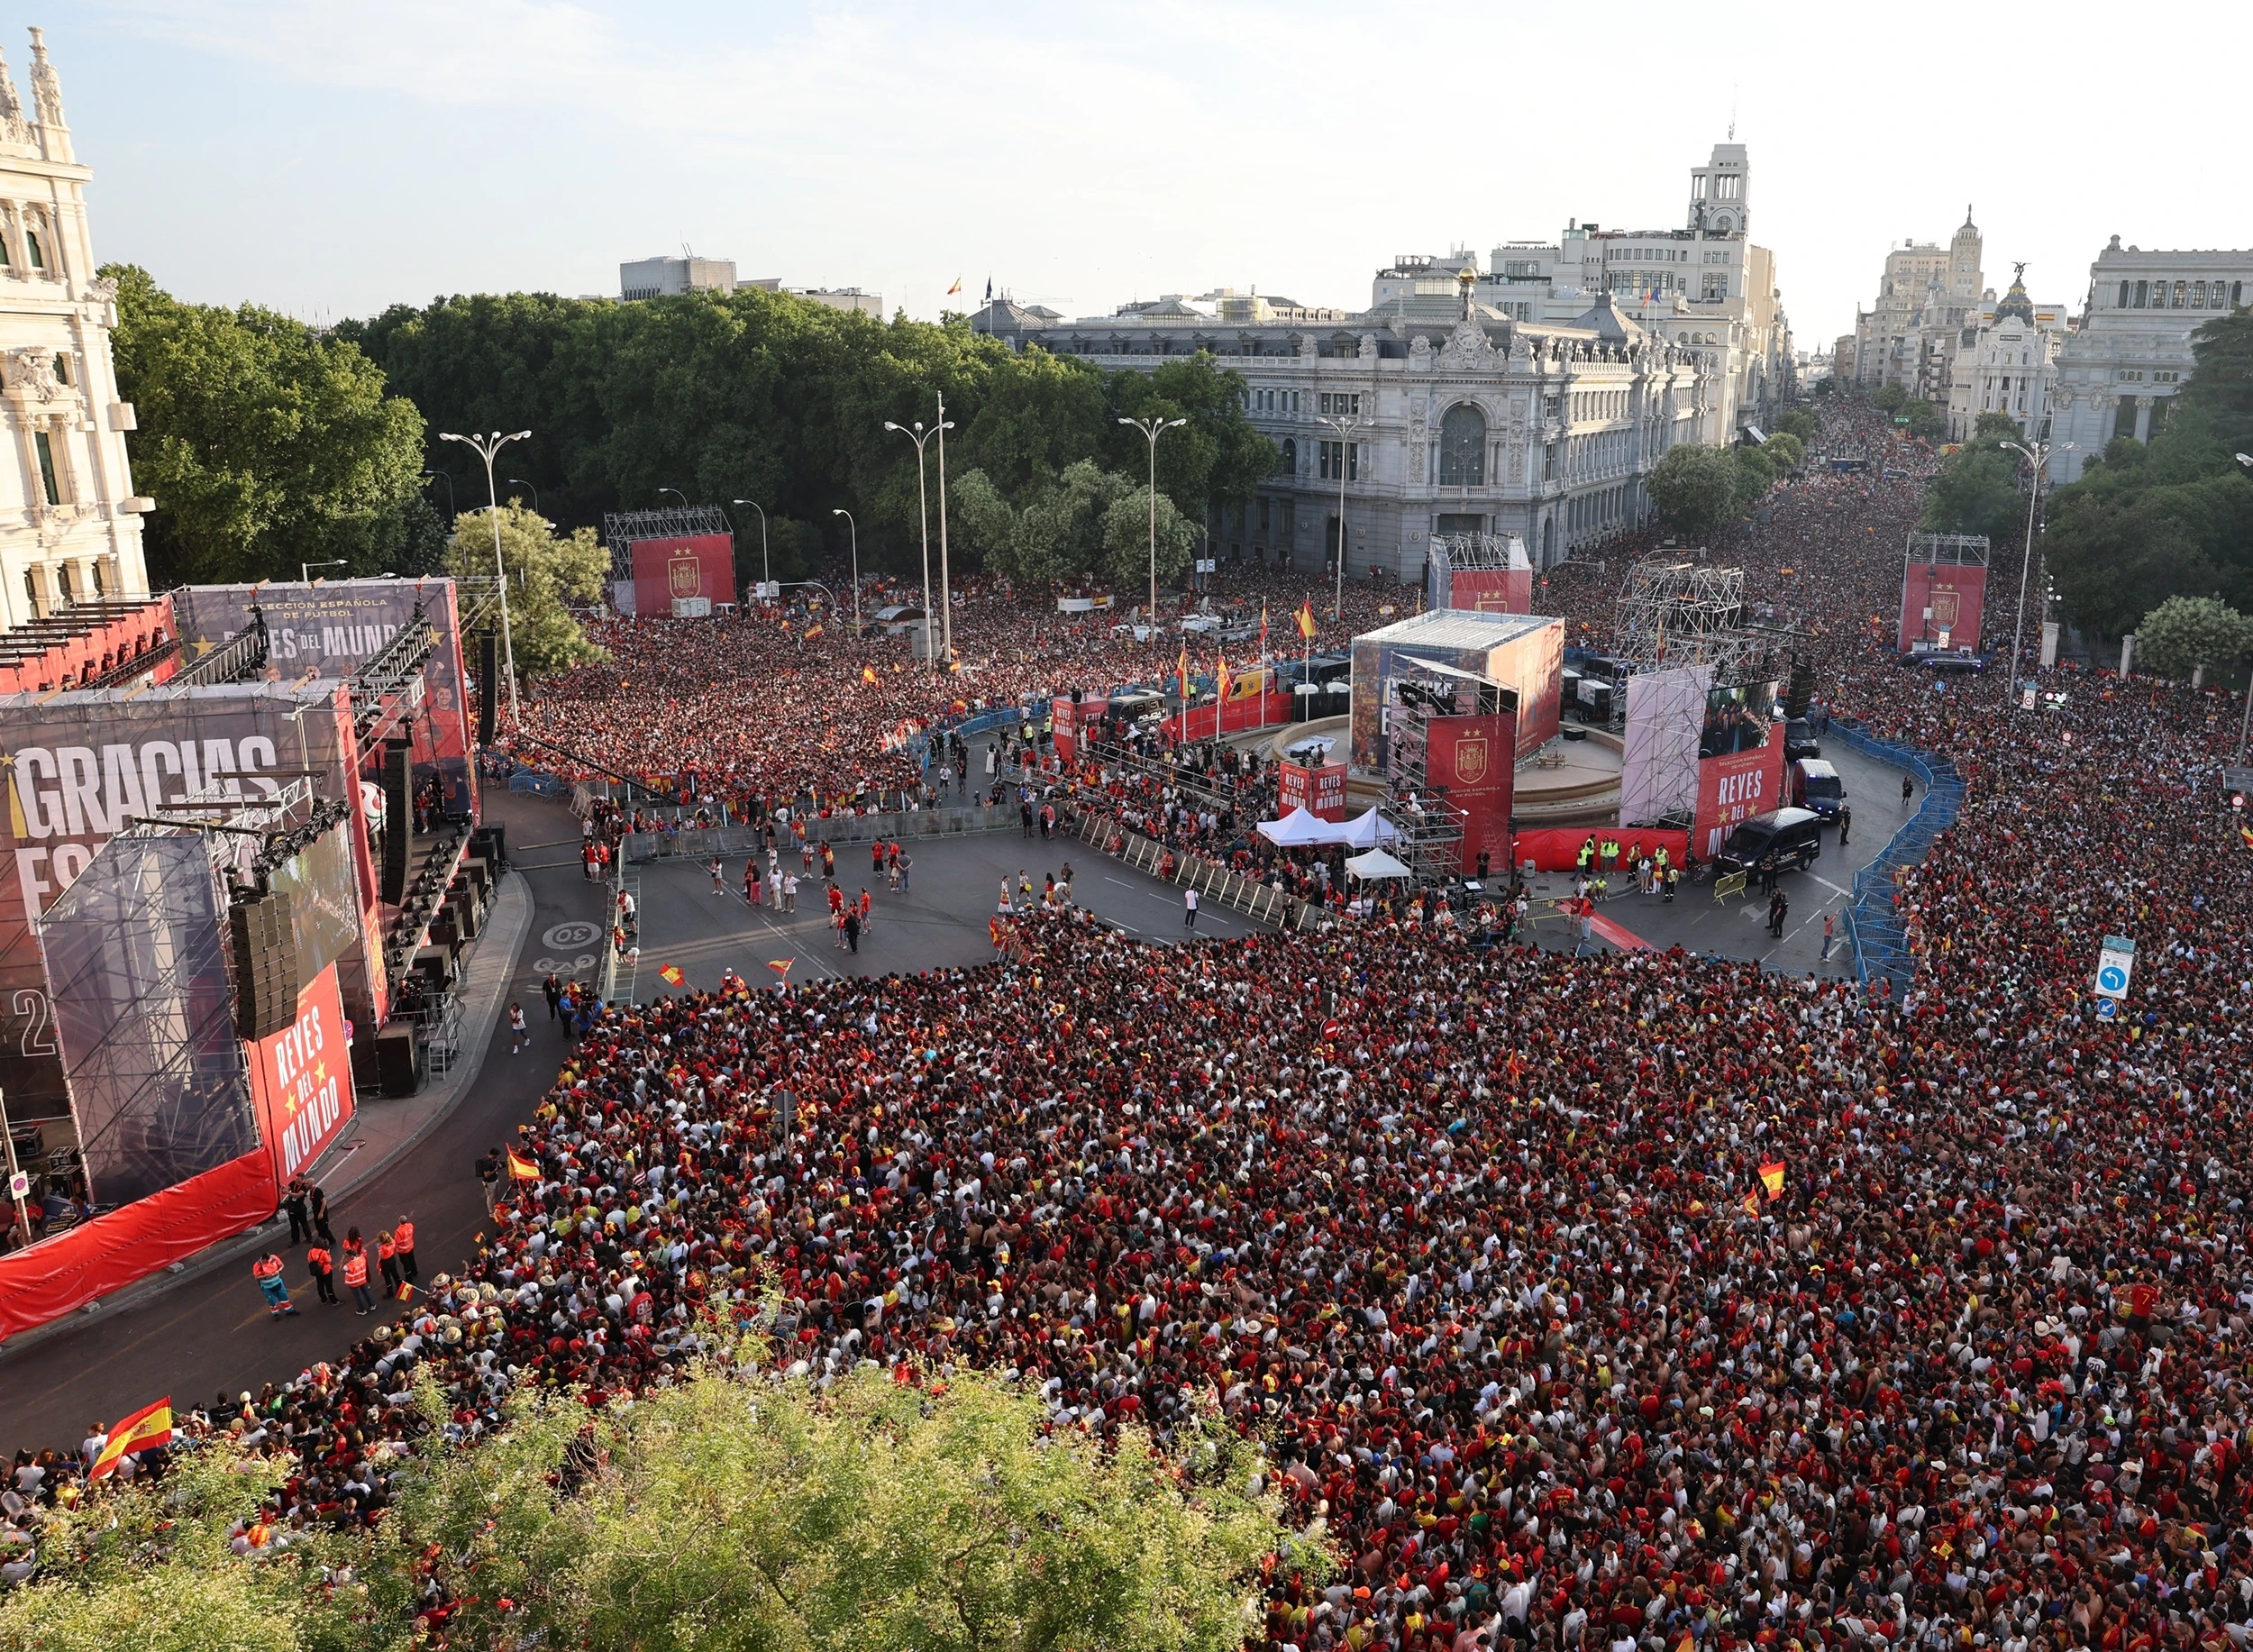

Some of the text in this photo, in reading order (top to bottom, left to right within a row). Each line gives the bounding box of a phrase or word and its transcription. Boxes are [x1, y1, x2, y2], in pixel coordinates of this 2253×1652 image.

[242, 598, 388, 611] SLECCIÓN ESPAÑOLA
[304, 608, 354, 618] FÚTBOL
[300, 634, 321, 650] DEL
[1285, 773, 1305, 790] REYES
[1319, 775, 1341, 789] REYES
[1718, 770, 1763, 806] REYES
[1316, 794, 1344, 810] MUNDO
[1731, 805, 1745, 821] DEL
[275, 1004, 323, 1091] REYES
[296, 1070, 314, 1105] DEL
[282, 1075, 340, 1178] MUNDO
[2142, 1292, 2150, 1304] 7
